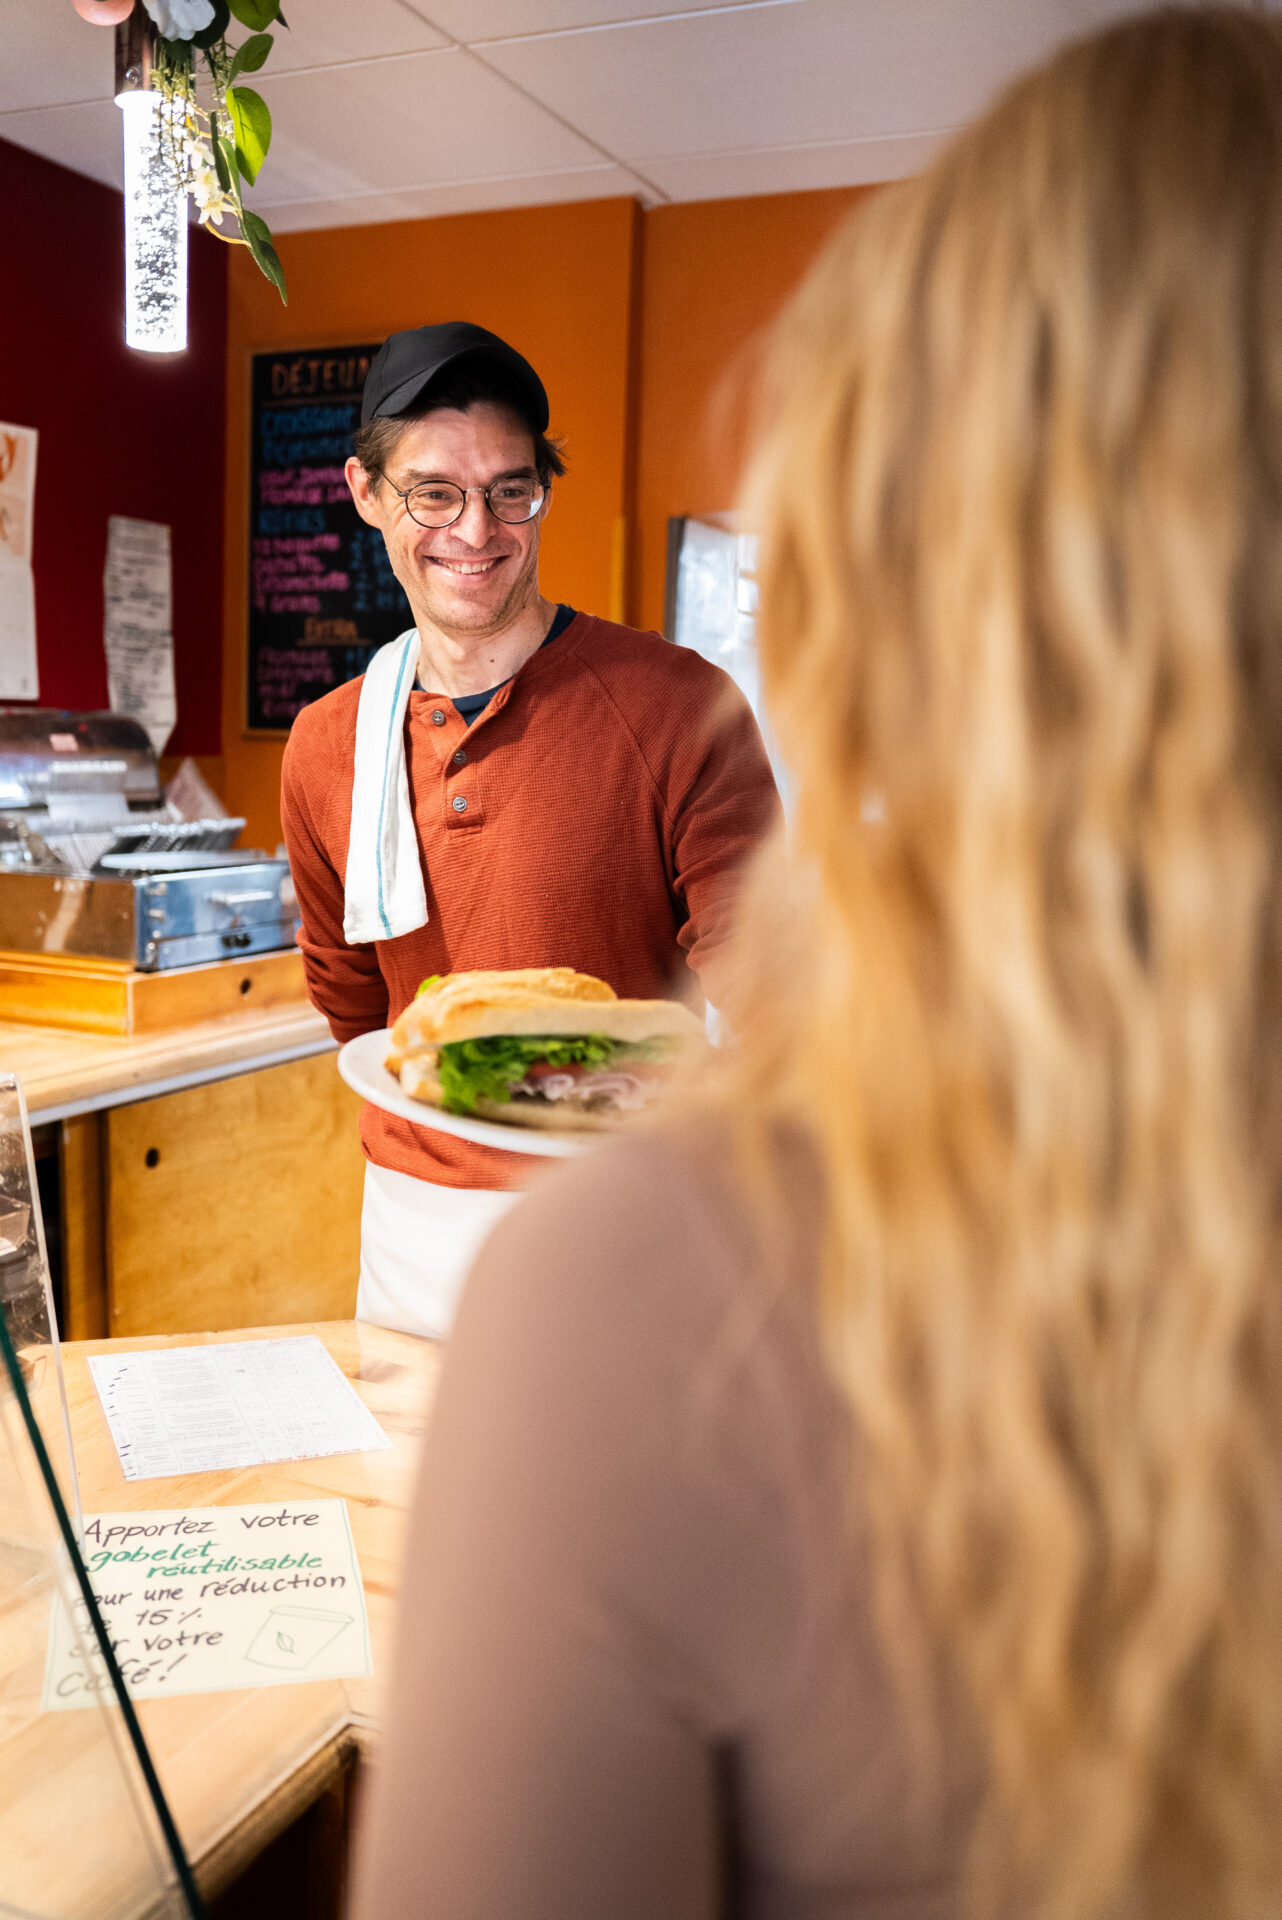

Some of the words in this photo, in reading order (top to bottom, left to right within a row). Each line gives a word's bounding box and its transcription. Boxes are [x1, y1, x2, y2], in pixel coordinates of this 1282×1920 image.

[85, 1516, 217, 1547] Apportez
[240, 1509, 320, 1529] votre
[85, 1540, 220, 1572] gobelet
[146, 1553, 323, 1579] réutilisable
[144, 1587, 183, 1601] une
[200, 1573, 346, 1598] réduction
[144, 1630, 223, 1651] votre
